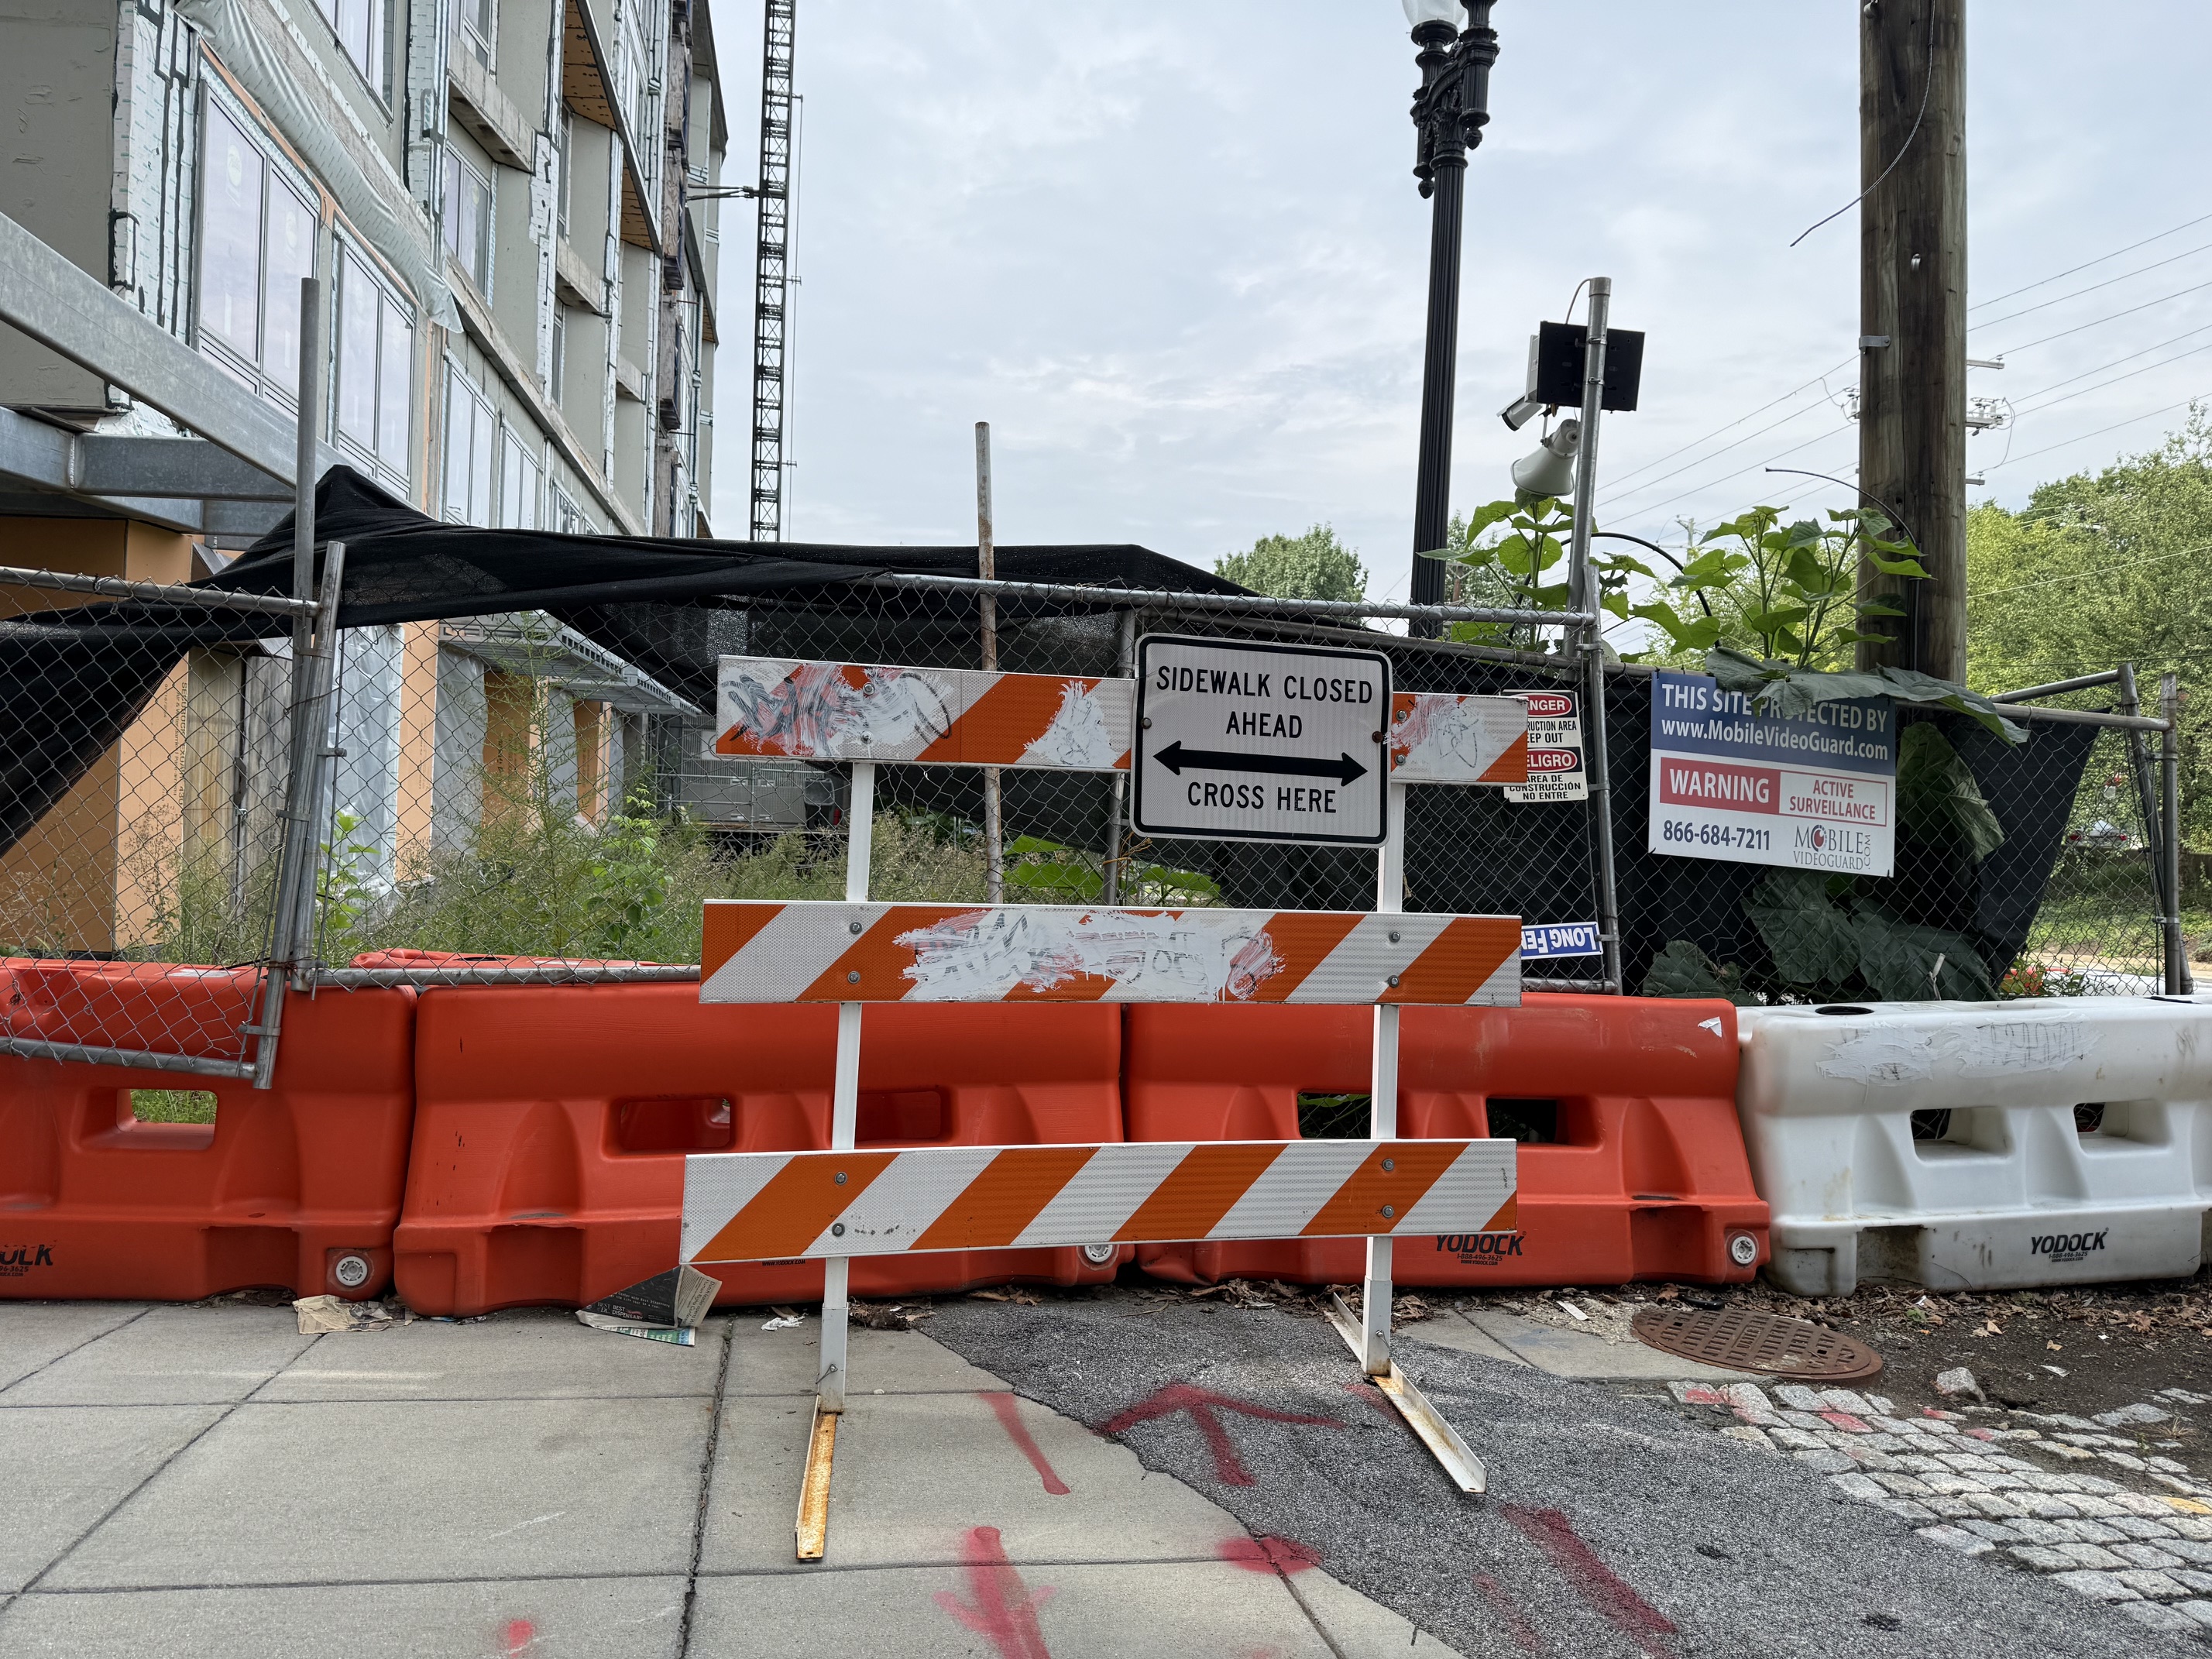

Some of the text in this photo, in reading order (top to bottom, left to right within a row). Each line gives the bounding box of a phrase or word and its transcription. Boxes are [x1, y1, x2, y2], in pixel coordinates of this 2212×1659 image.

[1156, 666, 1372, 704] SIDEWALK CLOSED
[1528, 700, 1565, 710] NGER
[1661, 683, 1707, 710] THIS
[1712, 689, 1753, 716] SITE
[1867, 708, 1887, 733] BY
[1225, 711, 1303, 739] AHEAD
[1558, 720, 1577, 730] AREA
[1545, 733, 1563, 743] OUT
[1661, 719, 1888, 761] www.MobileVideoGuard.com
[1187, 781, 1337, 813] CROSS HERE
[1670, 768, 1770, 804] WARNING
[1813, 779, 1854, 799] ACTIVE
[1789, 795, 1876, 820] SURVEILLANCE
[1663, 819, 1771, 850] 866-684-7211
[1793, 850, 1863, 870] VIDEOGUARD
[1549, 927, 1596, 950] LONG
[1436, 1234, 1524, 1255] YODOCK
[2031, 1231, 2107, 1254] YODOCK
